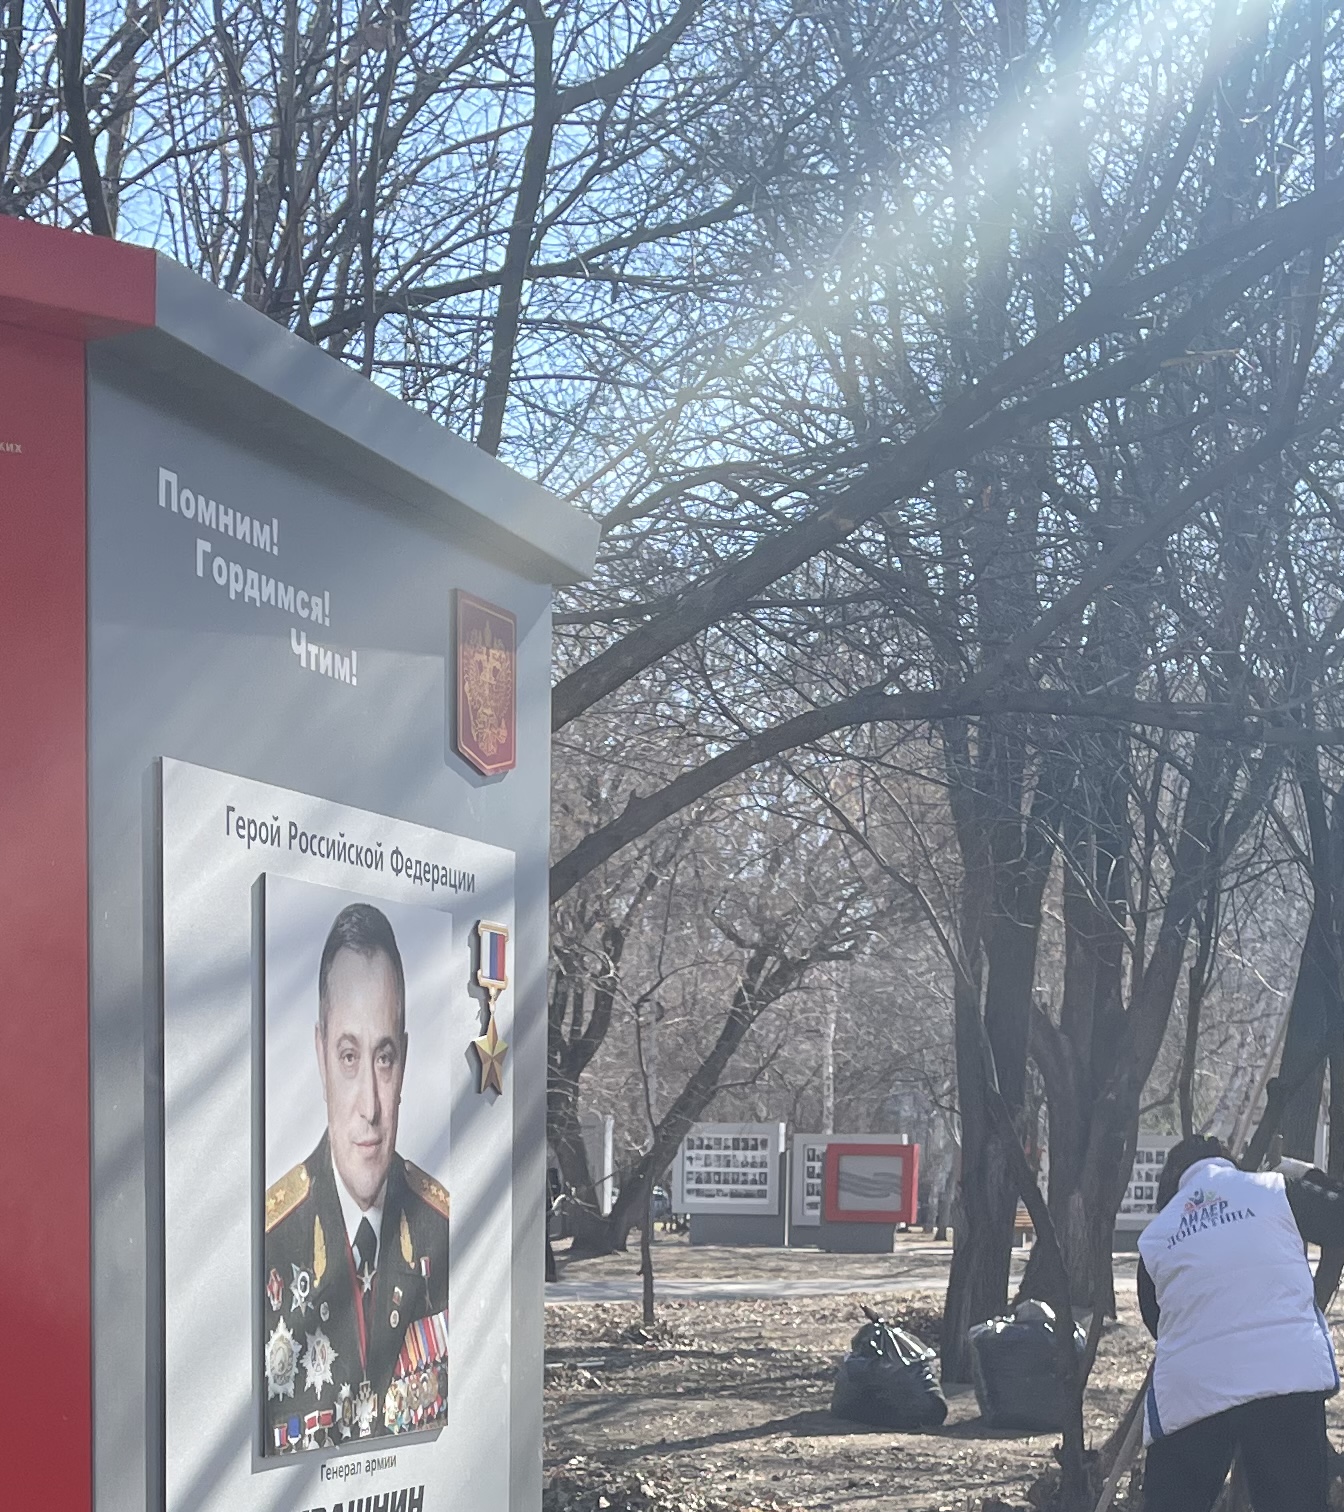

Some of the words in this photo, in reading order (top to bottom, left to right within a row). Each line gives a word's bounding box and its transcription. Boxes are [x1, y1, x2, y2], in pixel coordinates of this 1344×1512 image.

[158, 466, 278, 556] Помним!
[196, 538, 330, 627] Гордимся!
[290, 628, 357, 686] Чтим!
[226, 805, 281, 849] Герой
[288, 821, 384, 872] Российской
[390, 846, 475, 894] Федерации
[320, 1461, 361, 1482] Генерал
[364, 1454, 396, 1476] армии
